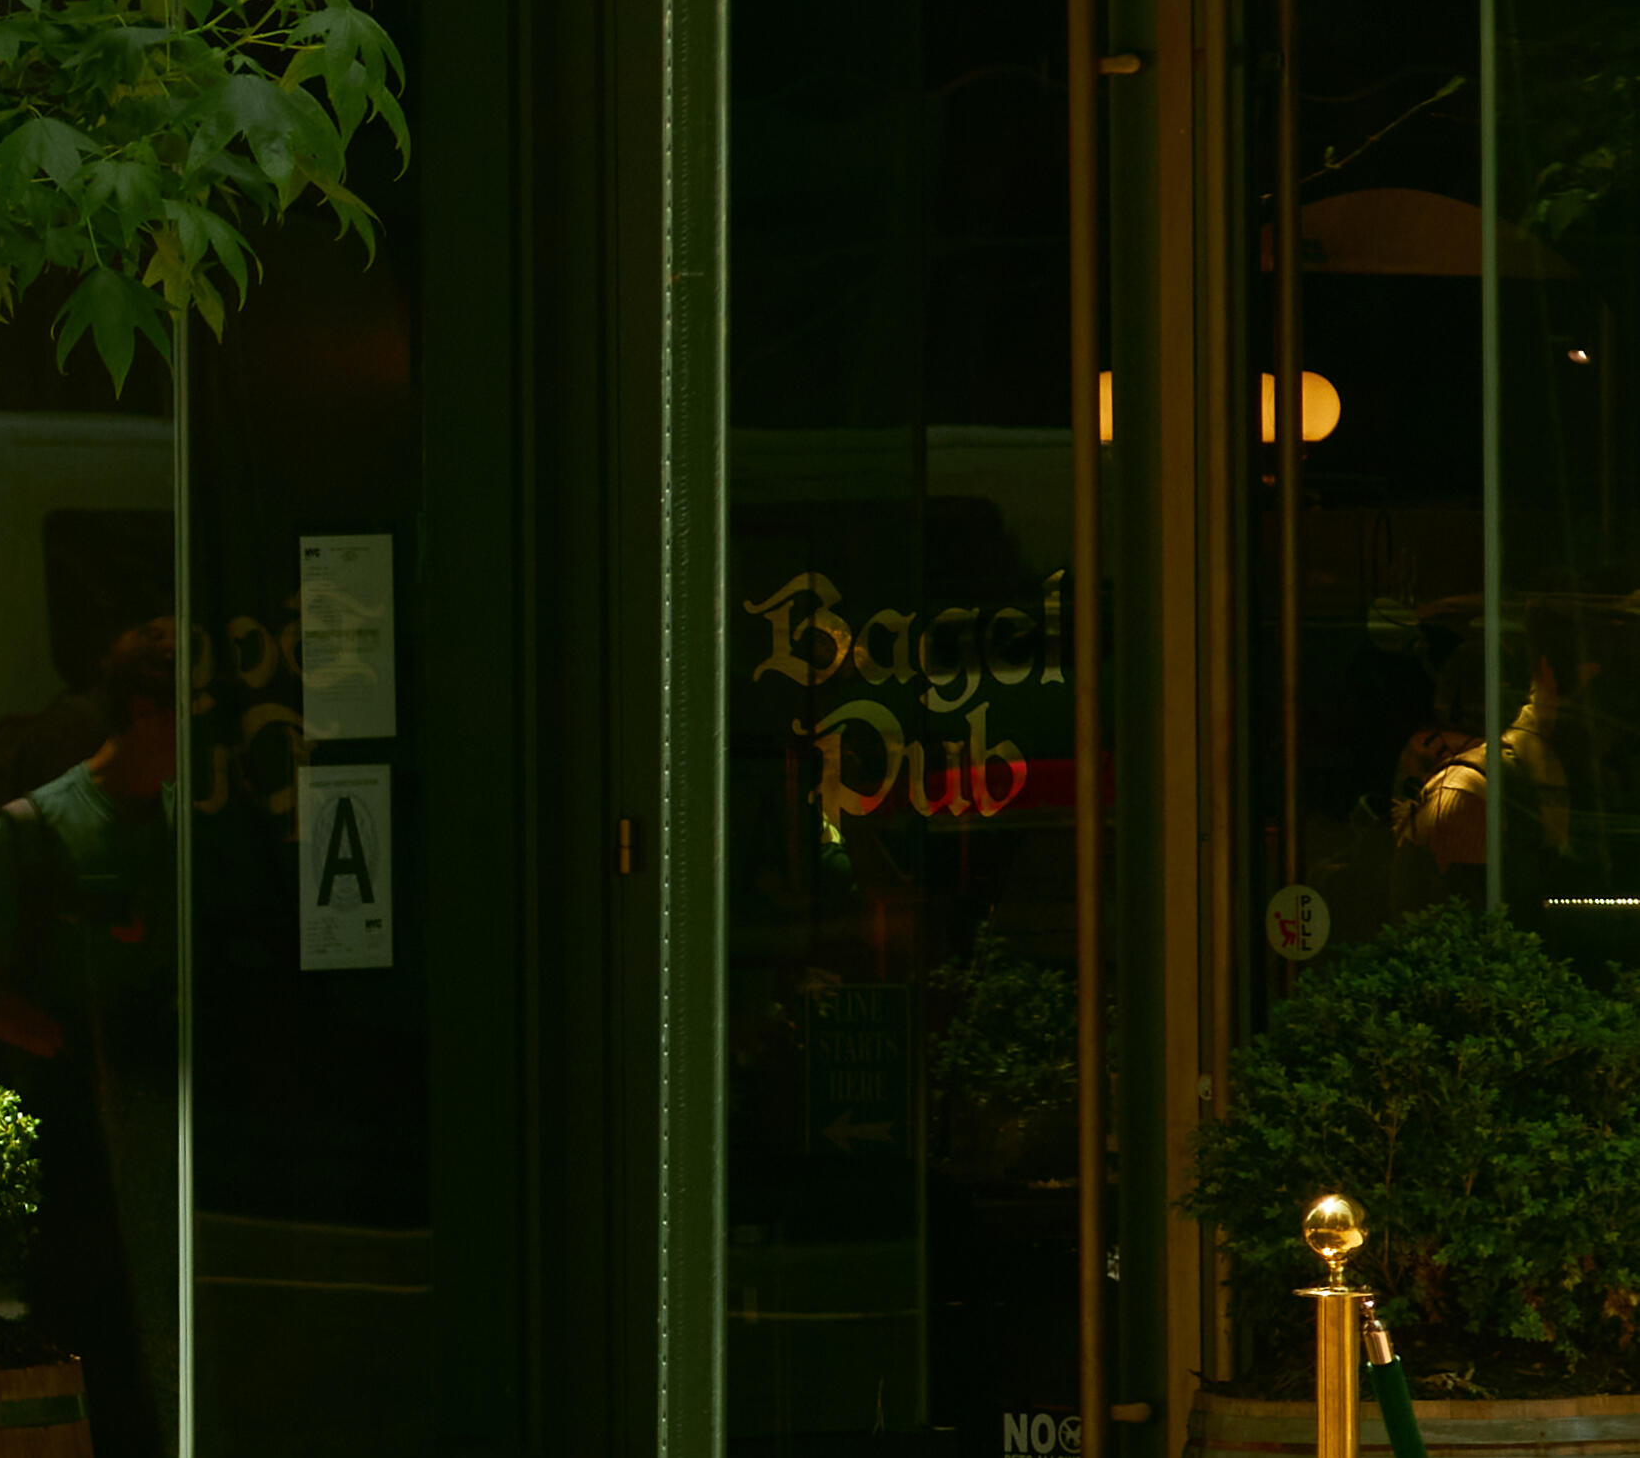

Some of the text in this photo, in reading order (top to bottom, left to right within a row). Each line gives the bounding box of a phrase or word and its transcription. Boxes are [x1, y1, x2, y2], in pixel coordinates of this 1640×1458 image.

[743, 569, 1066, 713] Bagel
[791, 700, 1028, 832] Pub
[317, 796, 377, 907] A
[1301, 894, 1313, 951] PULL
[818, 1031, 899, 1063] STARTS
[827, 1069, 884, 1103] HERE
[1004, 1412, 1056, 1455] NO
